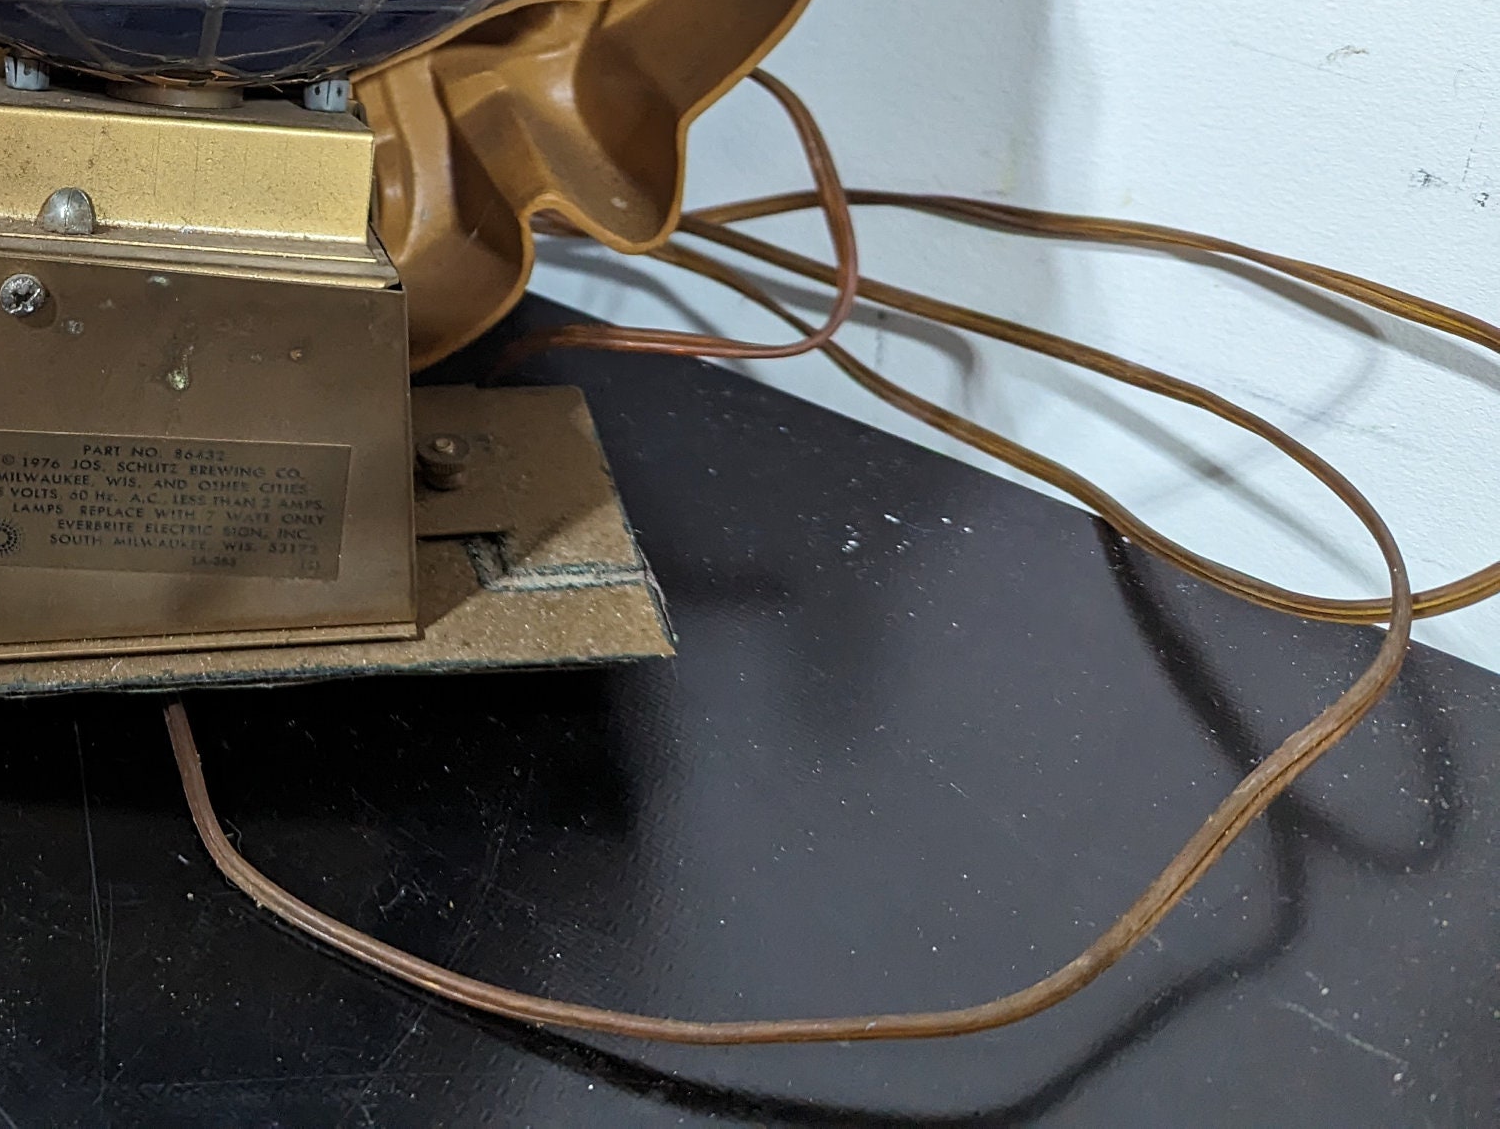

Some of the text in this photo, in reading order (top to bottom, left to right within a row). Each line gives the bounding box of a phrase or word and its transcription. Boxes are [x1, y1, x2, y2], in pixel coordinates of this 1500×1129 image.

[83, 444, 120, 457] PART
[131, 446, 162, 458] NO.
[22, 457, 60, 469] 1976
[72, 459, 105, 472] JOS.
[117, 461, 177, 474] SCHLITZ
[190, 464, 266, 479] BREWING
[154, 479, 188, 491] AND
[198, 480, 250, 493] OTHER
[69, 489, 88, 501] 60
[173, 495, 206, 507] LESS
[214, 496, 255, 509] THAN
[80, 505, 144, 518] REPLACE
[155, 508, 195, 520] WITH
[226, 511, 271, 524] WATT
[281, 513, 325, 527] ONLY
[57, 519, 134, 532] EVERBRITE
[145, 522, 213, 536] ELECTRIC
[50, 533, 102, 547] SOUTH
